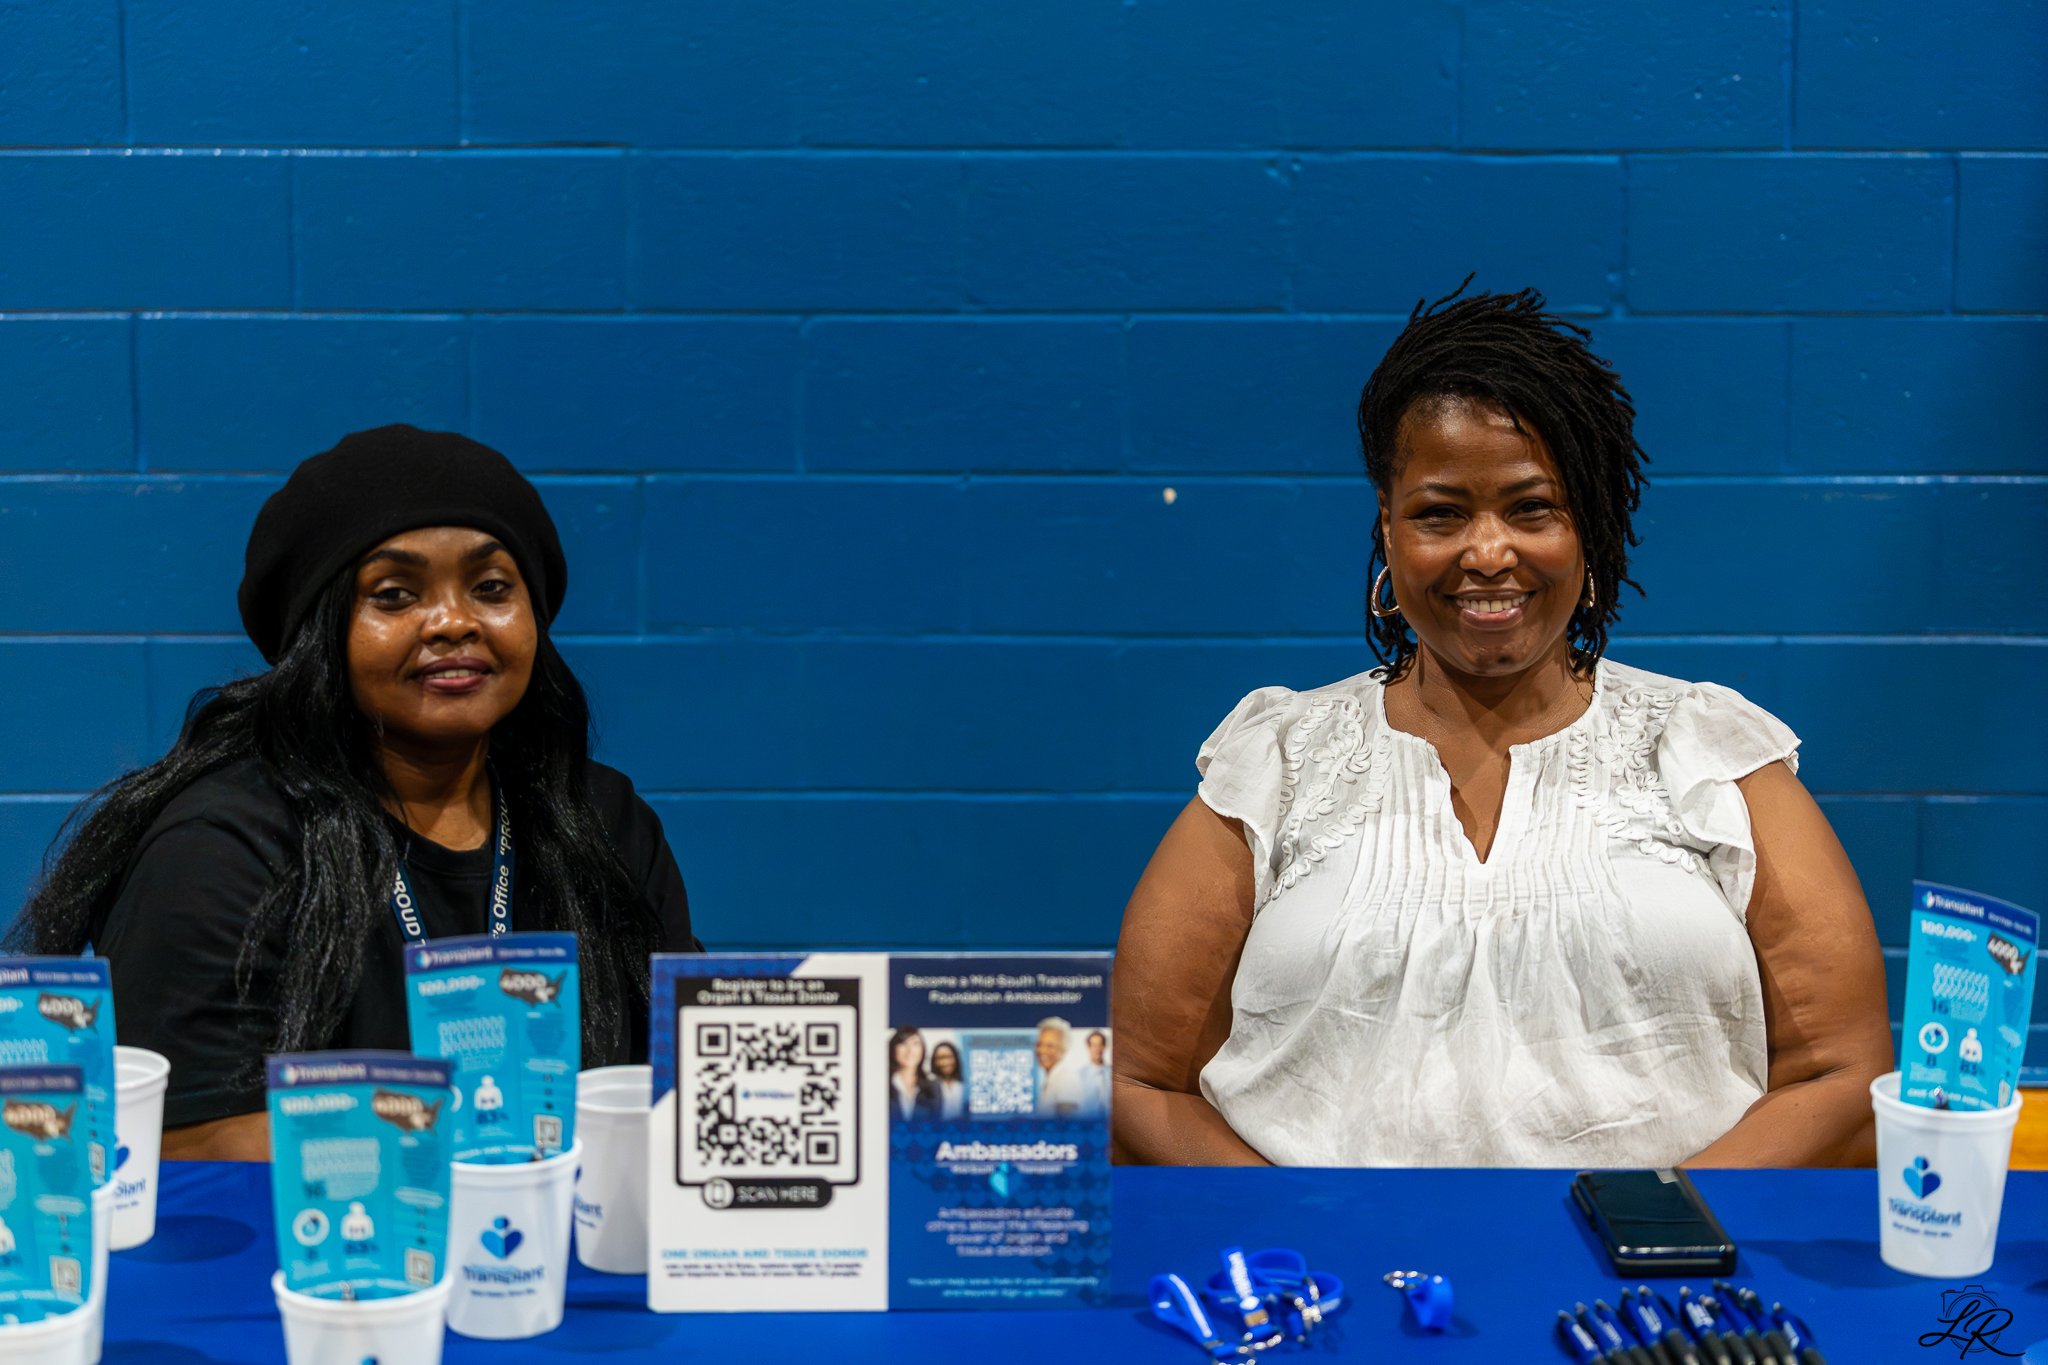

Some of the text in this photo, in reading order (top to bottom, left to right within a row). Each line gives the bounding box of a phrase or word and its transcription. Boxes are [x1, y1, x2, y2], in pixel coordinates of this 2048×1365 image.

[493, 865, 509, 919] Office
[905, 974, 957, 988] Become
[1036, 974, 1102, 989] Transplant
[697, 990, 740, 1005] Organ
[798, 990, 840, 1004] Donor
[928, 990, 1082, 1004] Foundation Ambassador
[935, 1140, 1078, 1161] Ambassadors
[736, 1185, 819, 1202] SCAN HERE
[937, 1207, 1022, 1219] Ambassadors
[1888, 1197, 1962, 1226] Transplant
